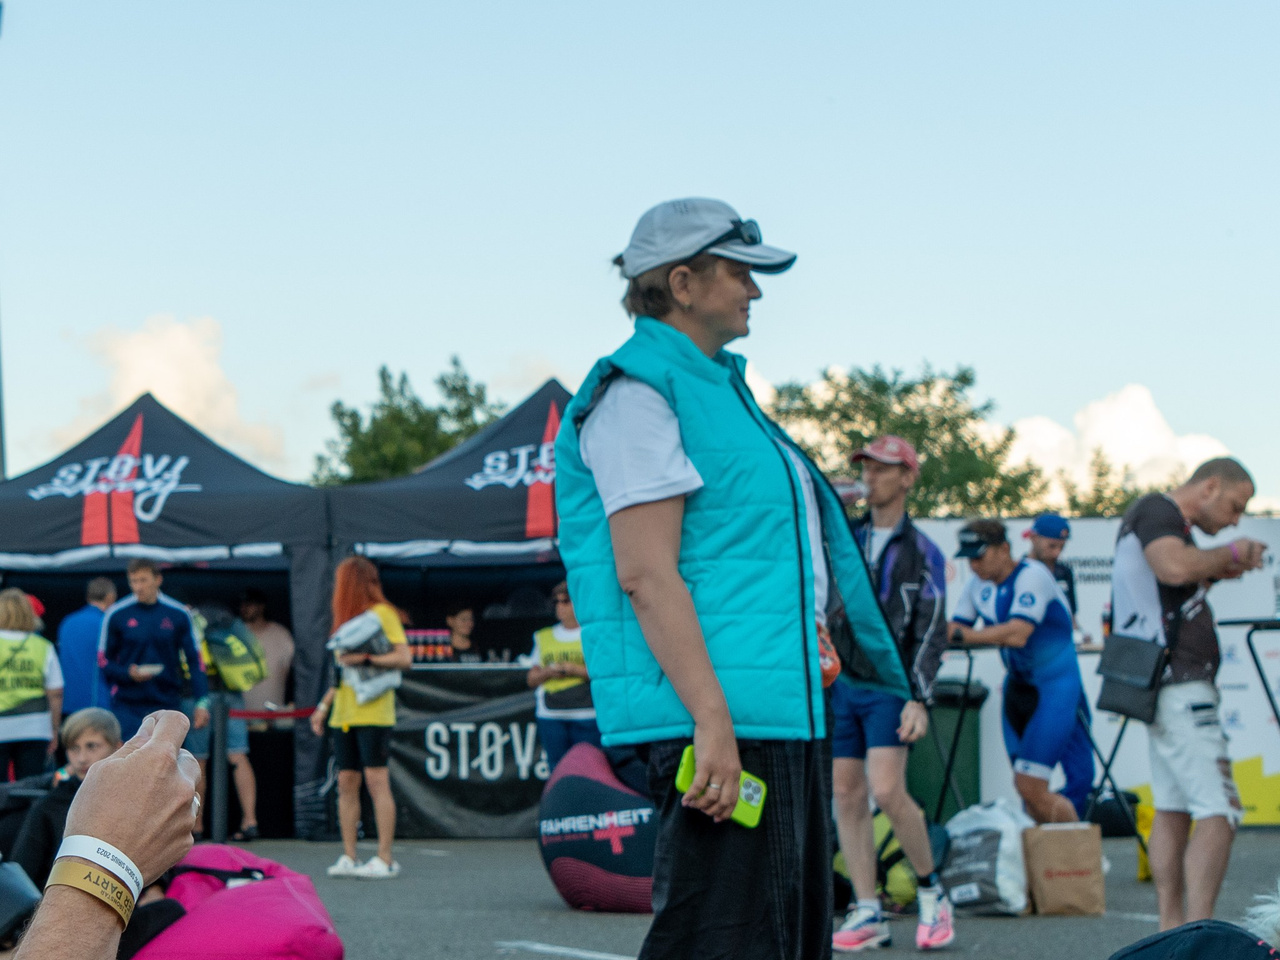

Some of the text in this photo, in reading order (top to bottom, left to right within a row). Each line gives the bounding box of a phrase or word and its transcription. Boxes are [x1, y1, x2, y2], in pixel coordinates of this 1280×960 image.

[540, 808, 653, 835] FAHRENHEIT
[96, 847, 111, 859] 2023
[83, 871, 124, 900] PARTY
